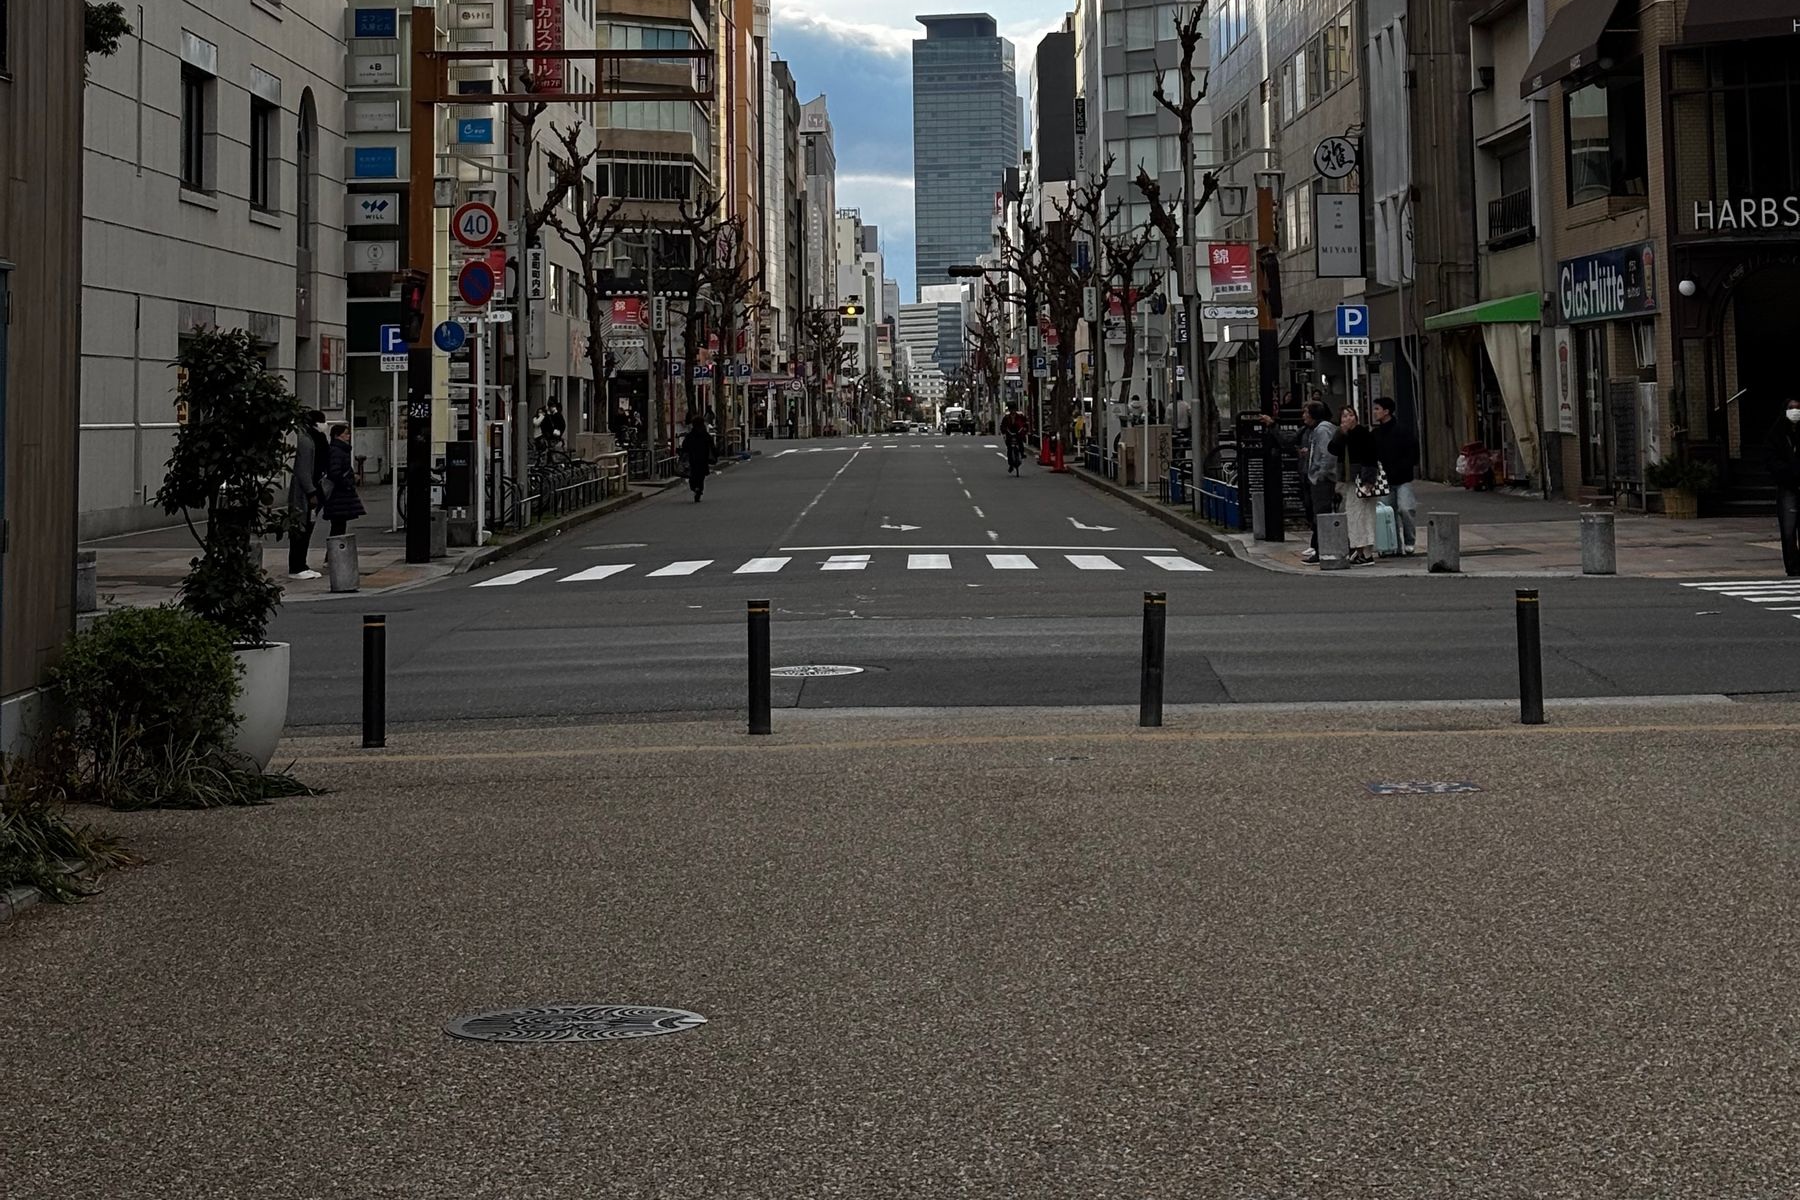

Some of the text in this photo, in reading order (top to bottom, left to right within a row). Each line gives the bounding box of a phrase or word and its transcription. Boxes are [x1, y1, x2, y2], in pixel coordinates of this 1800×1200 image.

[1321, 140, 1354, 171] 雅
[1693, 196, 1800, 230] HARBS
[463, 215, 488, 235] 40
[1212, 248, 1230, 265] 錦
[1321, 246, 1358, 254] MIYABI
[1344, 308, 1363, 334] P
[388, 327, 404, 351] P
[671, 363, 680, 375] P
